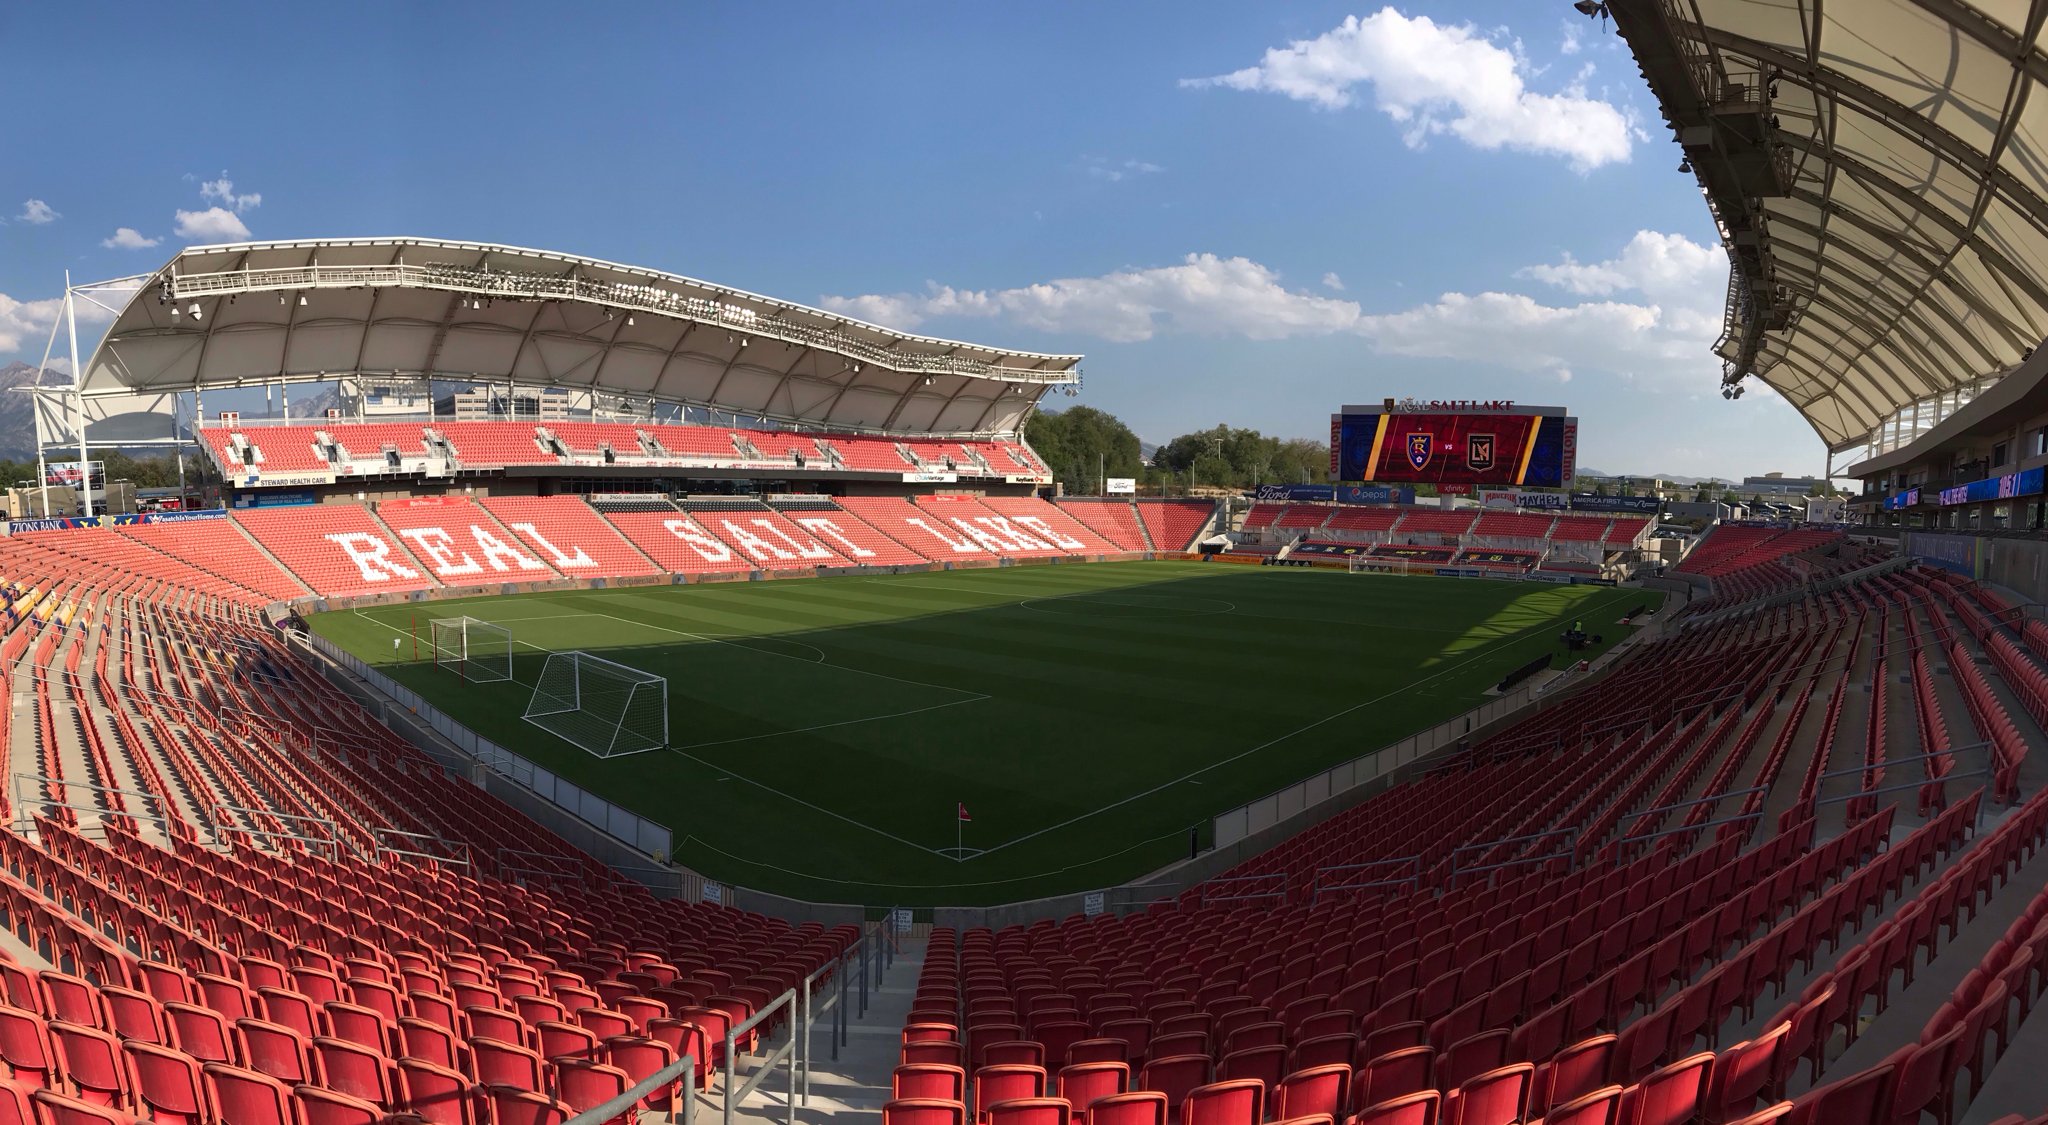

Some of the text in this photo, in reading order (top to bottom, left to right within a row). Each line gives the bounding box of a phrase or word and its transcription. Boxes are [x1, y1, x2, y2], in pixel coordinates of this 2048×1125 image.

[1399, 398, 1515, 413] REAL SALT LAKE
[1562, 424, 1576, 481] RioTinto
[1257, 485, 1291, 500] Ford
[1362, 491, 1387, 500] pepsi
[1444, 485, 1465, 493] xfinity
[1485, 492, 1560, 506] MAVERIK MAYHEM
[12, 520, 62, 533] ZIONS BANK
[323, 516, 1086, 582] REAL SALT LAKE
[617, 576, 654, 587] Continental
